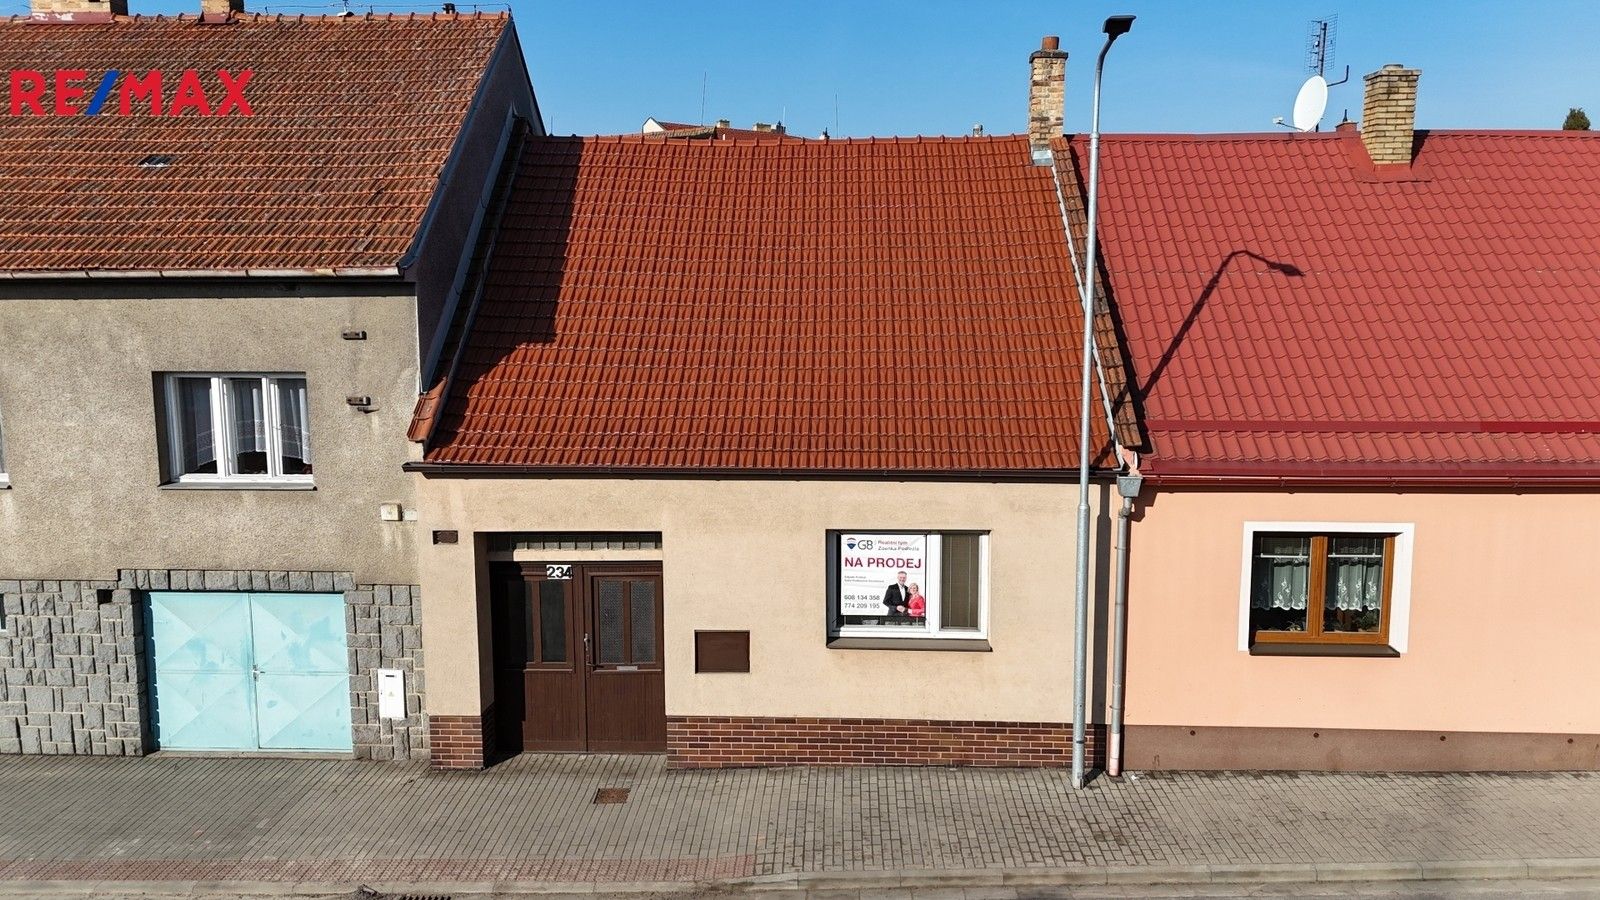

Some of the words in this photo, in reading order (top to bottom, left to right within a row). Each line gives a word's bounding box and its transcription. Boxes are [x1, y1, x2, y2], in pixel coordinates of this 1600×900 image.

[844, 557, 863, 568] NA
[867, 557, 922, 569] PRODEJ
[546, 566, 572, 579] 234
